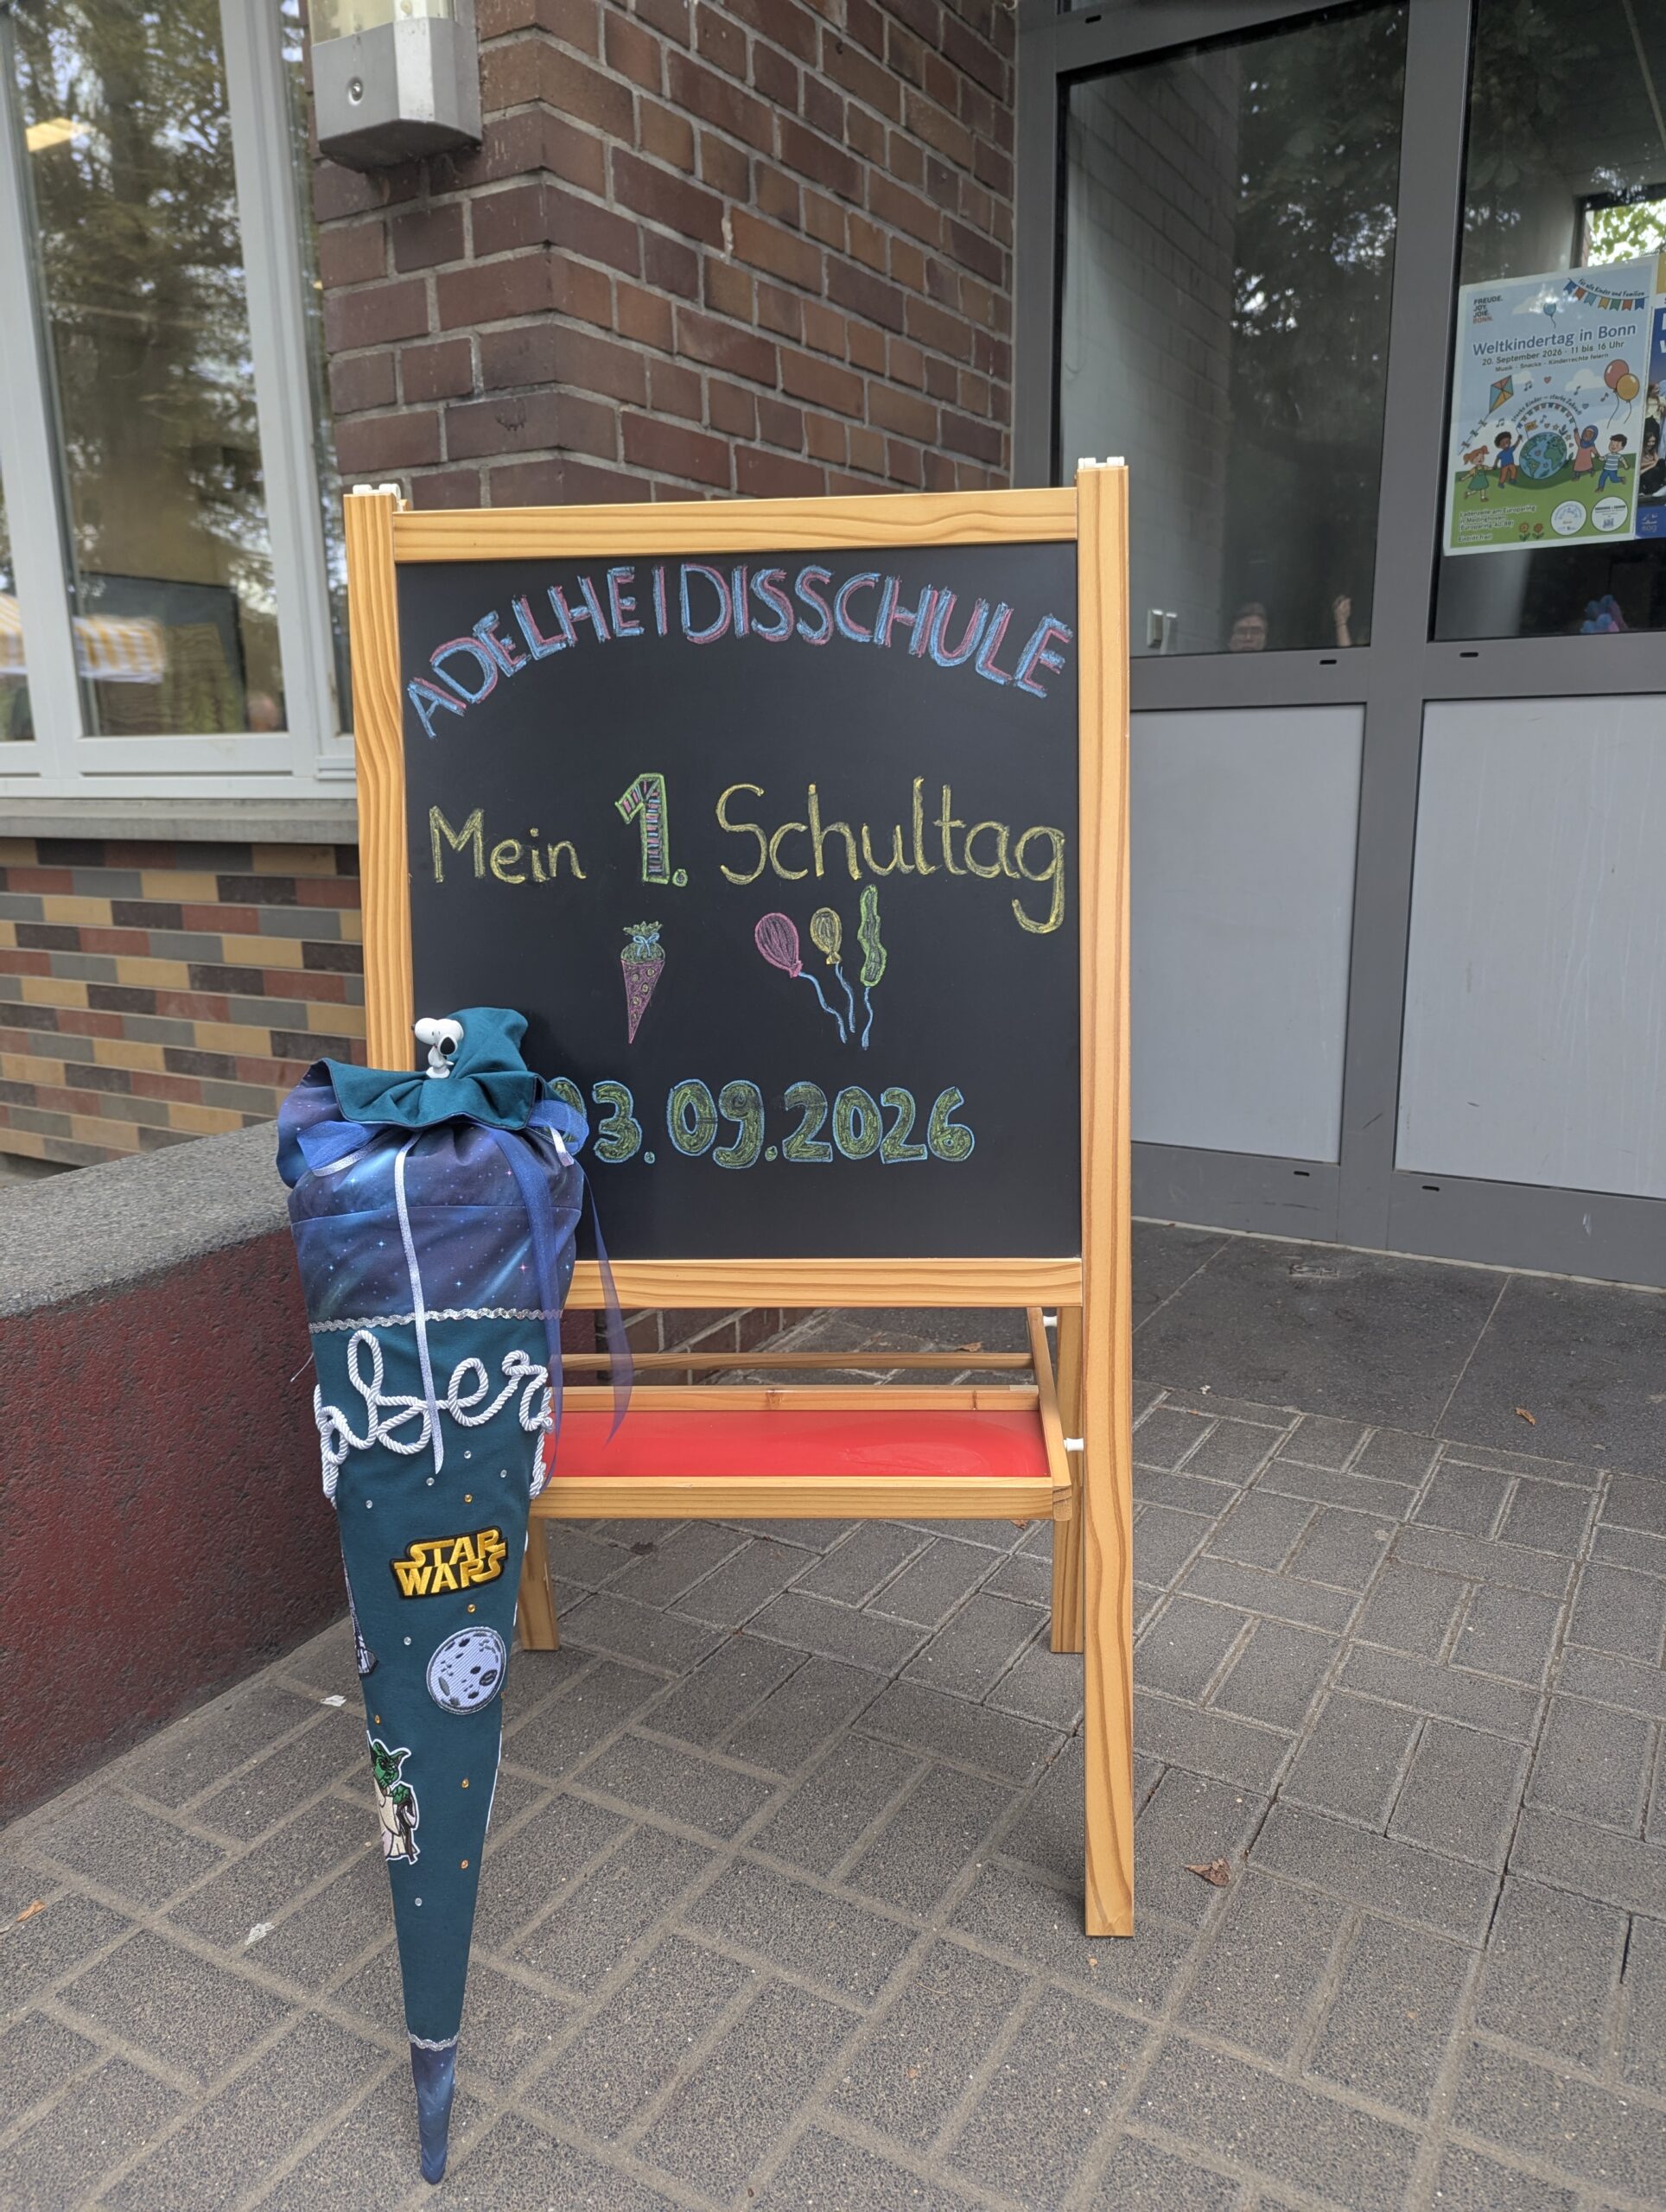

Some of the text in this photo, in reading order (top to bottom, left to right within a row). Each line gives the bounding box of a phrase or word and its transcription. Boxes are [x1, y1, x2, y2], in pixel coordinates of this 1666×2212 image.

[1473, 324, 1637, 355] Weltkindertag in Bonn
[1496, 353, 1540, 365] September
[1542, 348, 1562, 358] 2026
[1581, 344, 1594, 353] bis
[1609, 340, 1625, 349] Uhr
[407, 563, 1075, 739] ADELHEIDISSCHULE
[428, 772, 1066, 934] Mein 1. Schultag
[393, 1529, 506, 1569] STAR
[395, 1548, 506, 1597] WARS
